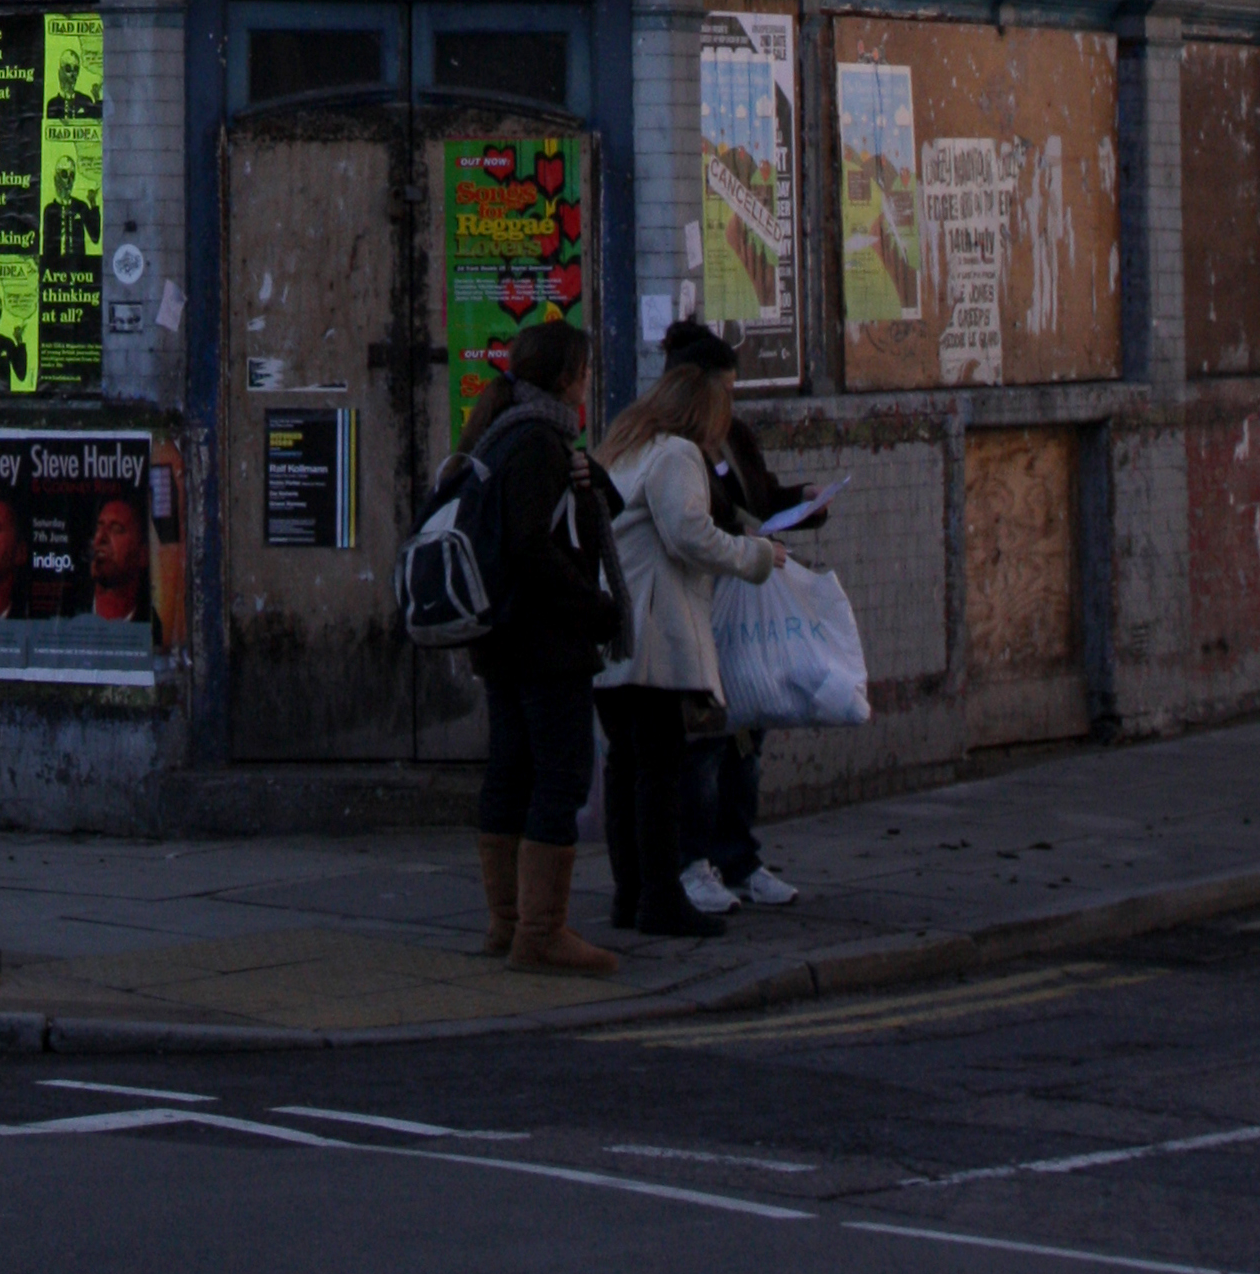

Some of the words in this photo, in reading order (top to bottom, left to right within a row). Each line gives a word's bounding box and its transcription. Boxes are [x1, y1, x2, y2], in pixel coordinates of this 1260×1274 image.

[76, 22, 103, 34] IDEA
[73, 128, 99, 139] IDEA
[460, 157, 481, 166] OUT
[456, 182, 537, 211] Songs
[710, 157, 783, 242] CANCELLED
[479, 201, 507, 218] for
[456, 213, 555, 242] Reggae
[455, 232, 542, 258] Lovers
[0, 264, 27, 277] IDEA
[42, 269, 68, 283] Are
[70, 272, 94, 285] you
[42, 288, 100, 306] thinking
[41, 309, 55, 322] at
[60, 308, 83, 322] all?
[464, 349, 485, 358] OUT
[30, 443, 79, 478] Steve
[83, 442, 145, 488] Harley
[269, 464, 287, 473] Ralf
[32, 517, 65, 530] Saturday
[33, 531, 47, 543] 7th
[50, 532, 68, 544] June
